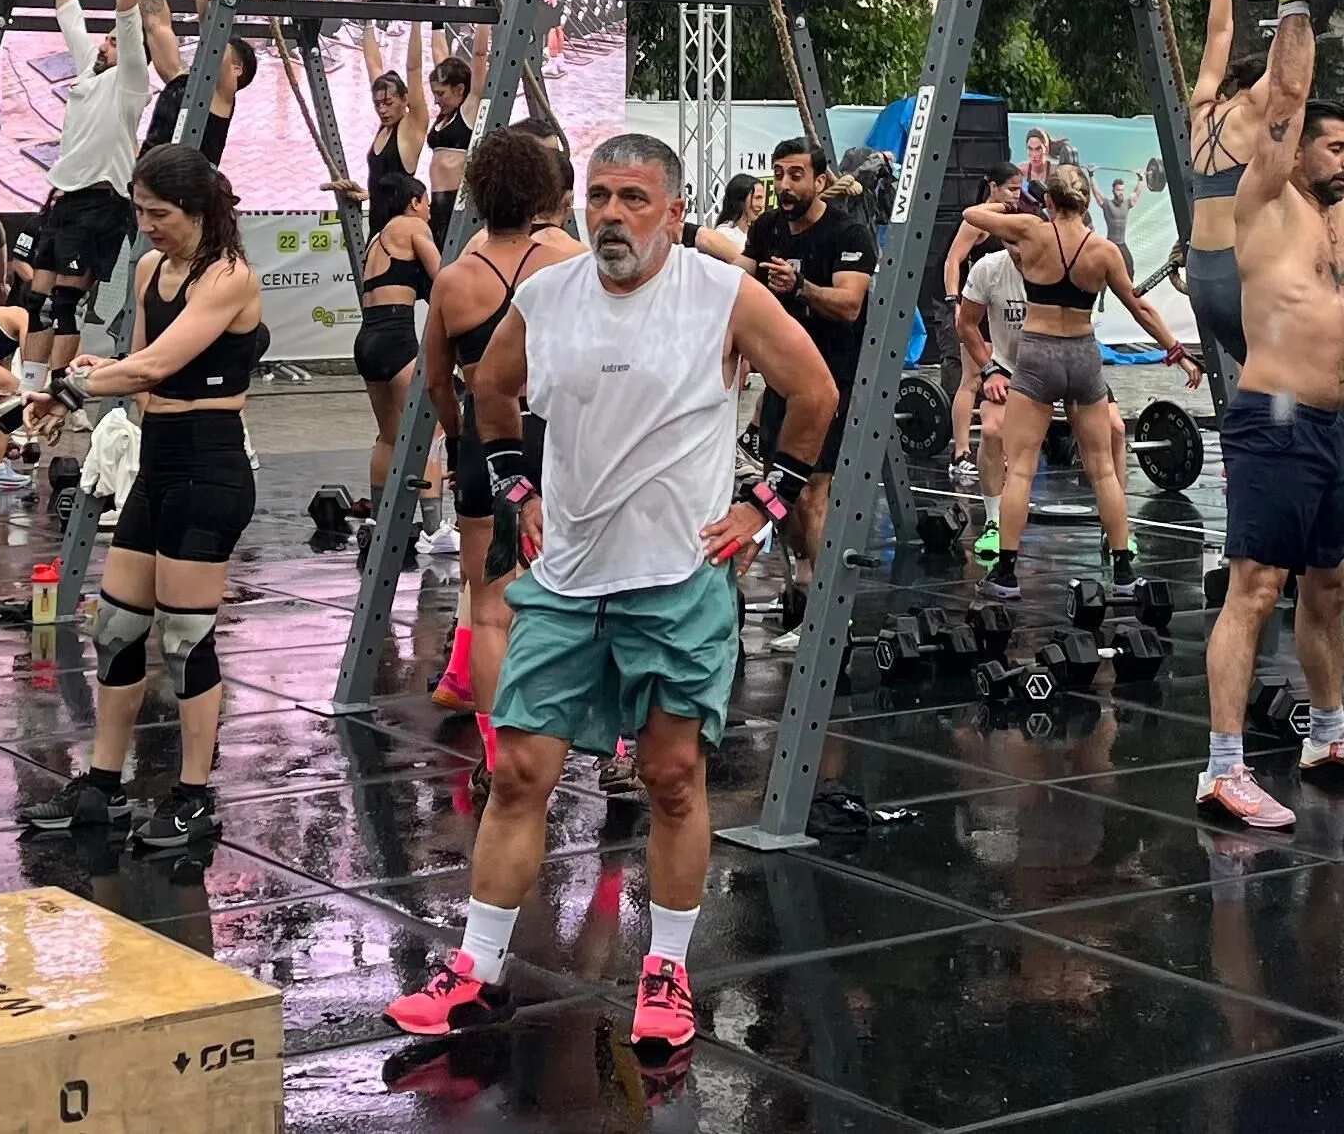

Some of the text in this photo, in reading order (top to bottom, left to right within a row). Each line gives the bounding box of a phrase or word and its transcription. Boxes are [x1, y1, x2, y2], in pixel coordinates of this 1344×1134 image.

[279, 235, 329, 248] 22 23
[261, 272, 321, 286] CENTER
[200, 1038, 256, 1073] 50
